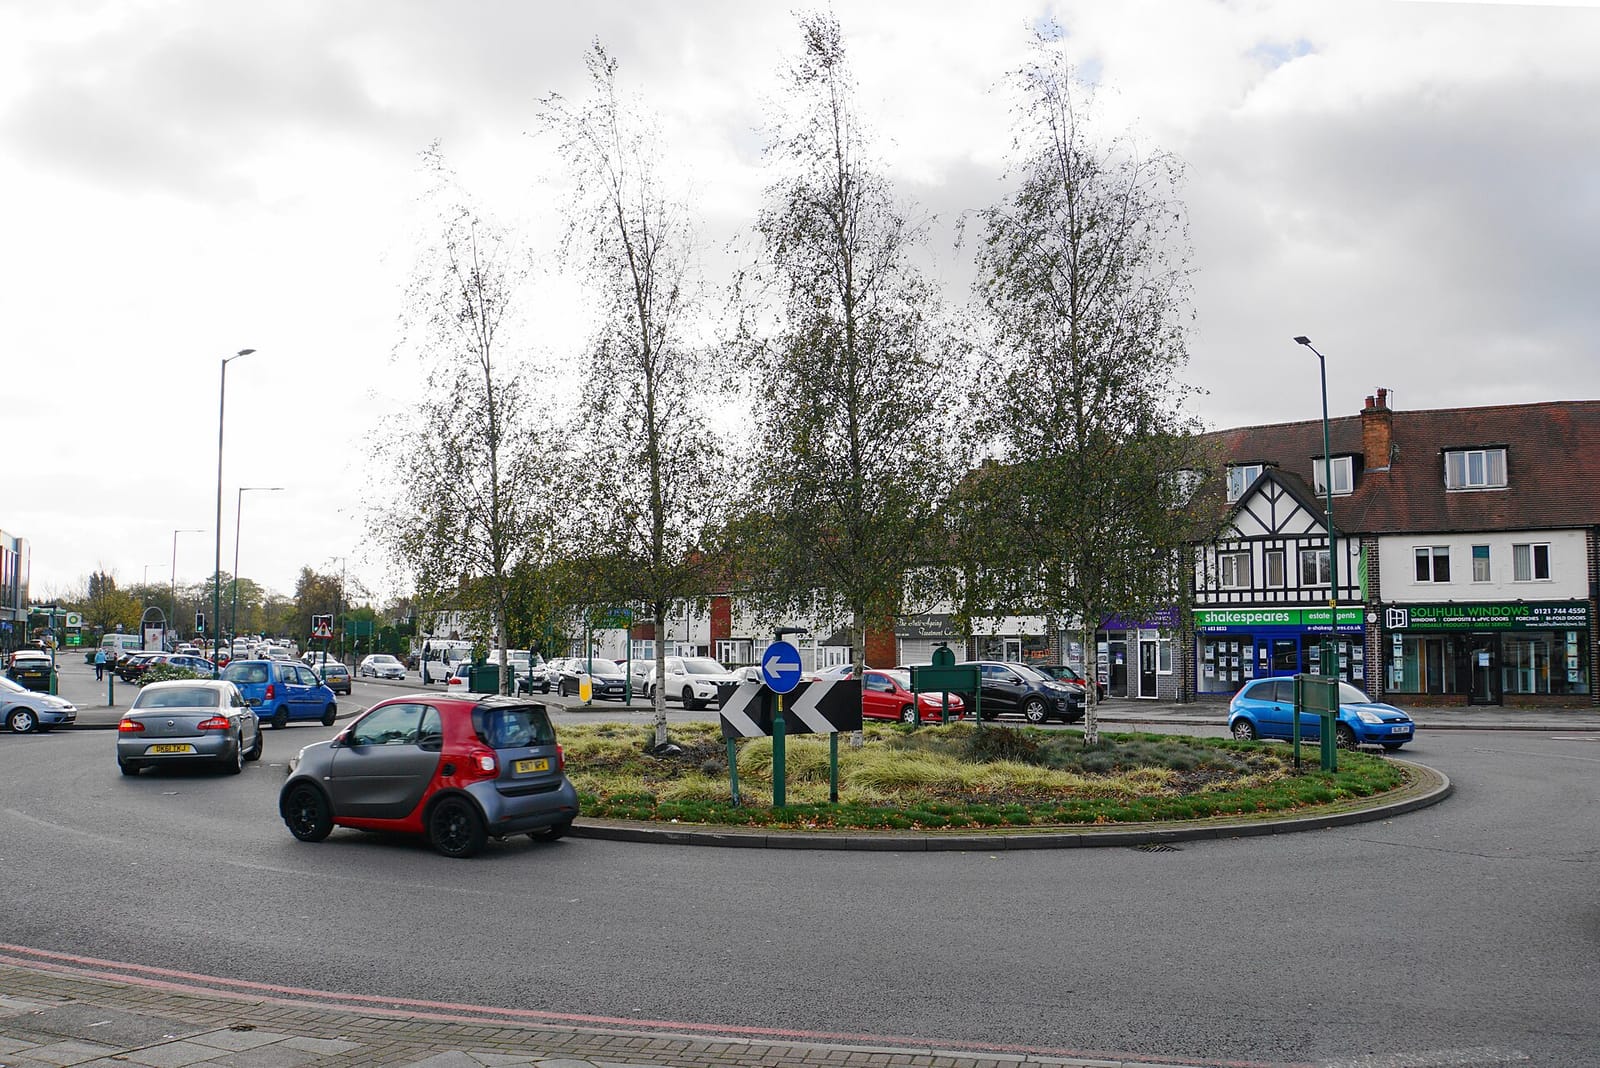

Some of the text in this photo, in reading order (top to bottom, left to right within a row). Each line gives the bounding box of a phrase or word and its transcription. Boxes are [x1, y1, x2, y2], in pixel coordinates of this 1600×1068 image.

[1333, 612, 1356, 620] gents
[1411, 606, 1529, 617] SOLIHULL WINDOWS
[1205, 611, 1289, 624] shakespeares
